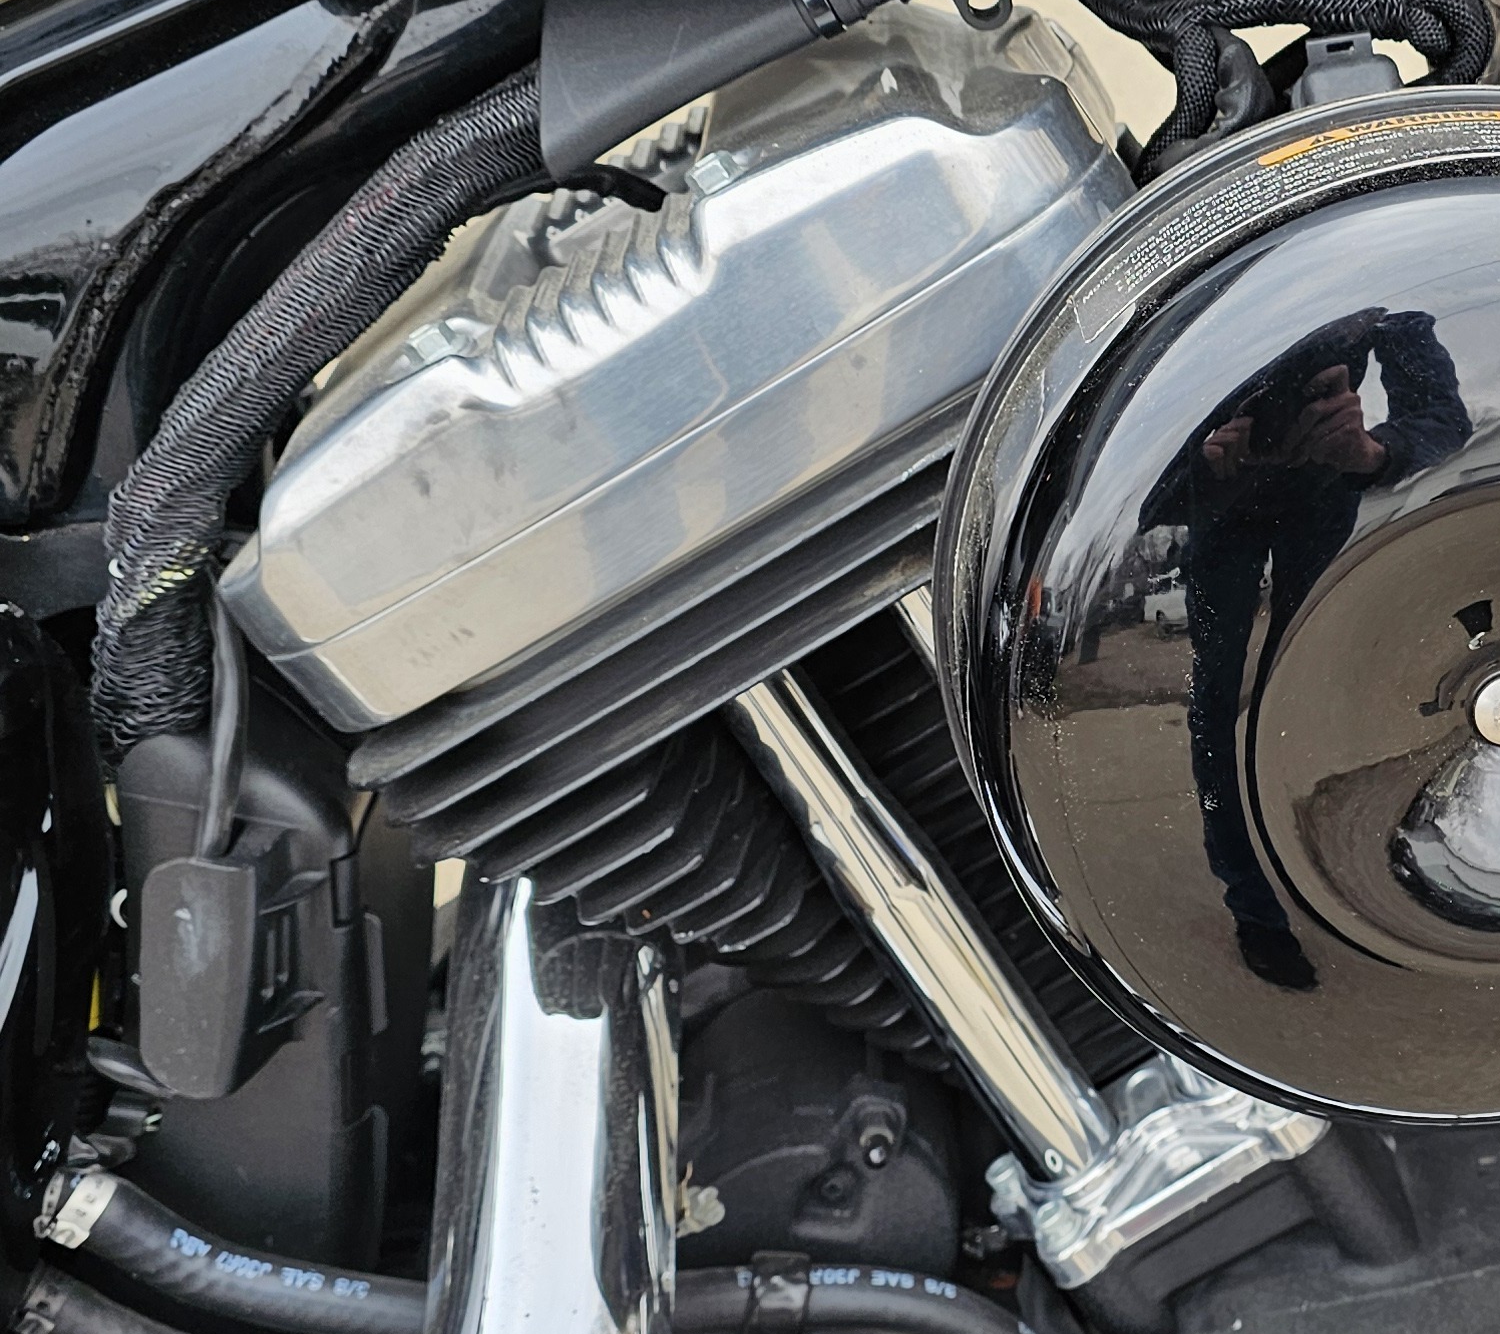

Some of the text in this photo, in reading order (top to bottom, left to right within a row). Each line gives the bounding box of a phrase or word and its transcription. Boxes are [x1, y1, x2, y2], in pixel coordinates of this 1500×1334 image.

[1347, 112, 1499, 132] WARNING
[1123, 247, 1157, 279] Take
[1170, 213, 1204, 242] rider
[1205, 182, 1259, 221] training
[1130, 214, 1190, 266] Unskilled
[1081, 232, 1155, 304] Motorcycles
[1158, 215, 1179, 236] are
[275, 1257, 327, 1299] SAE
[869, 1268, 915, 1289] SAE
